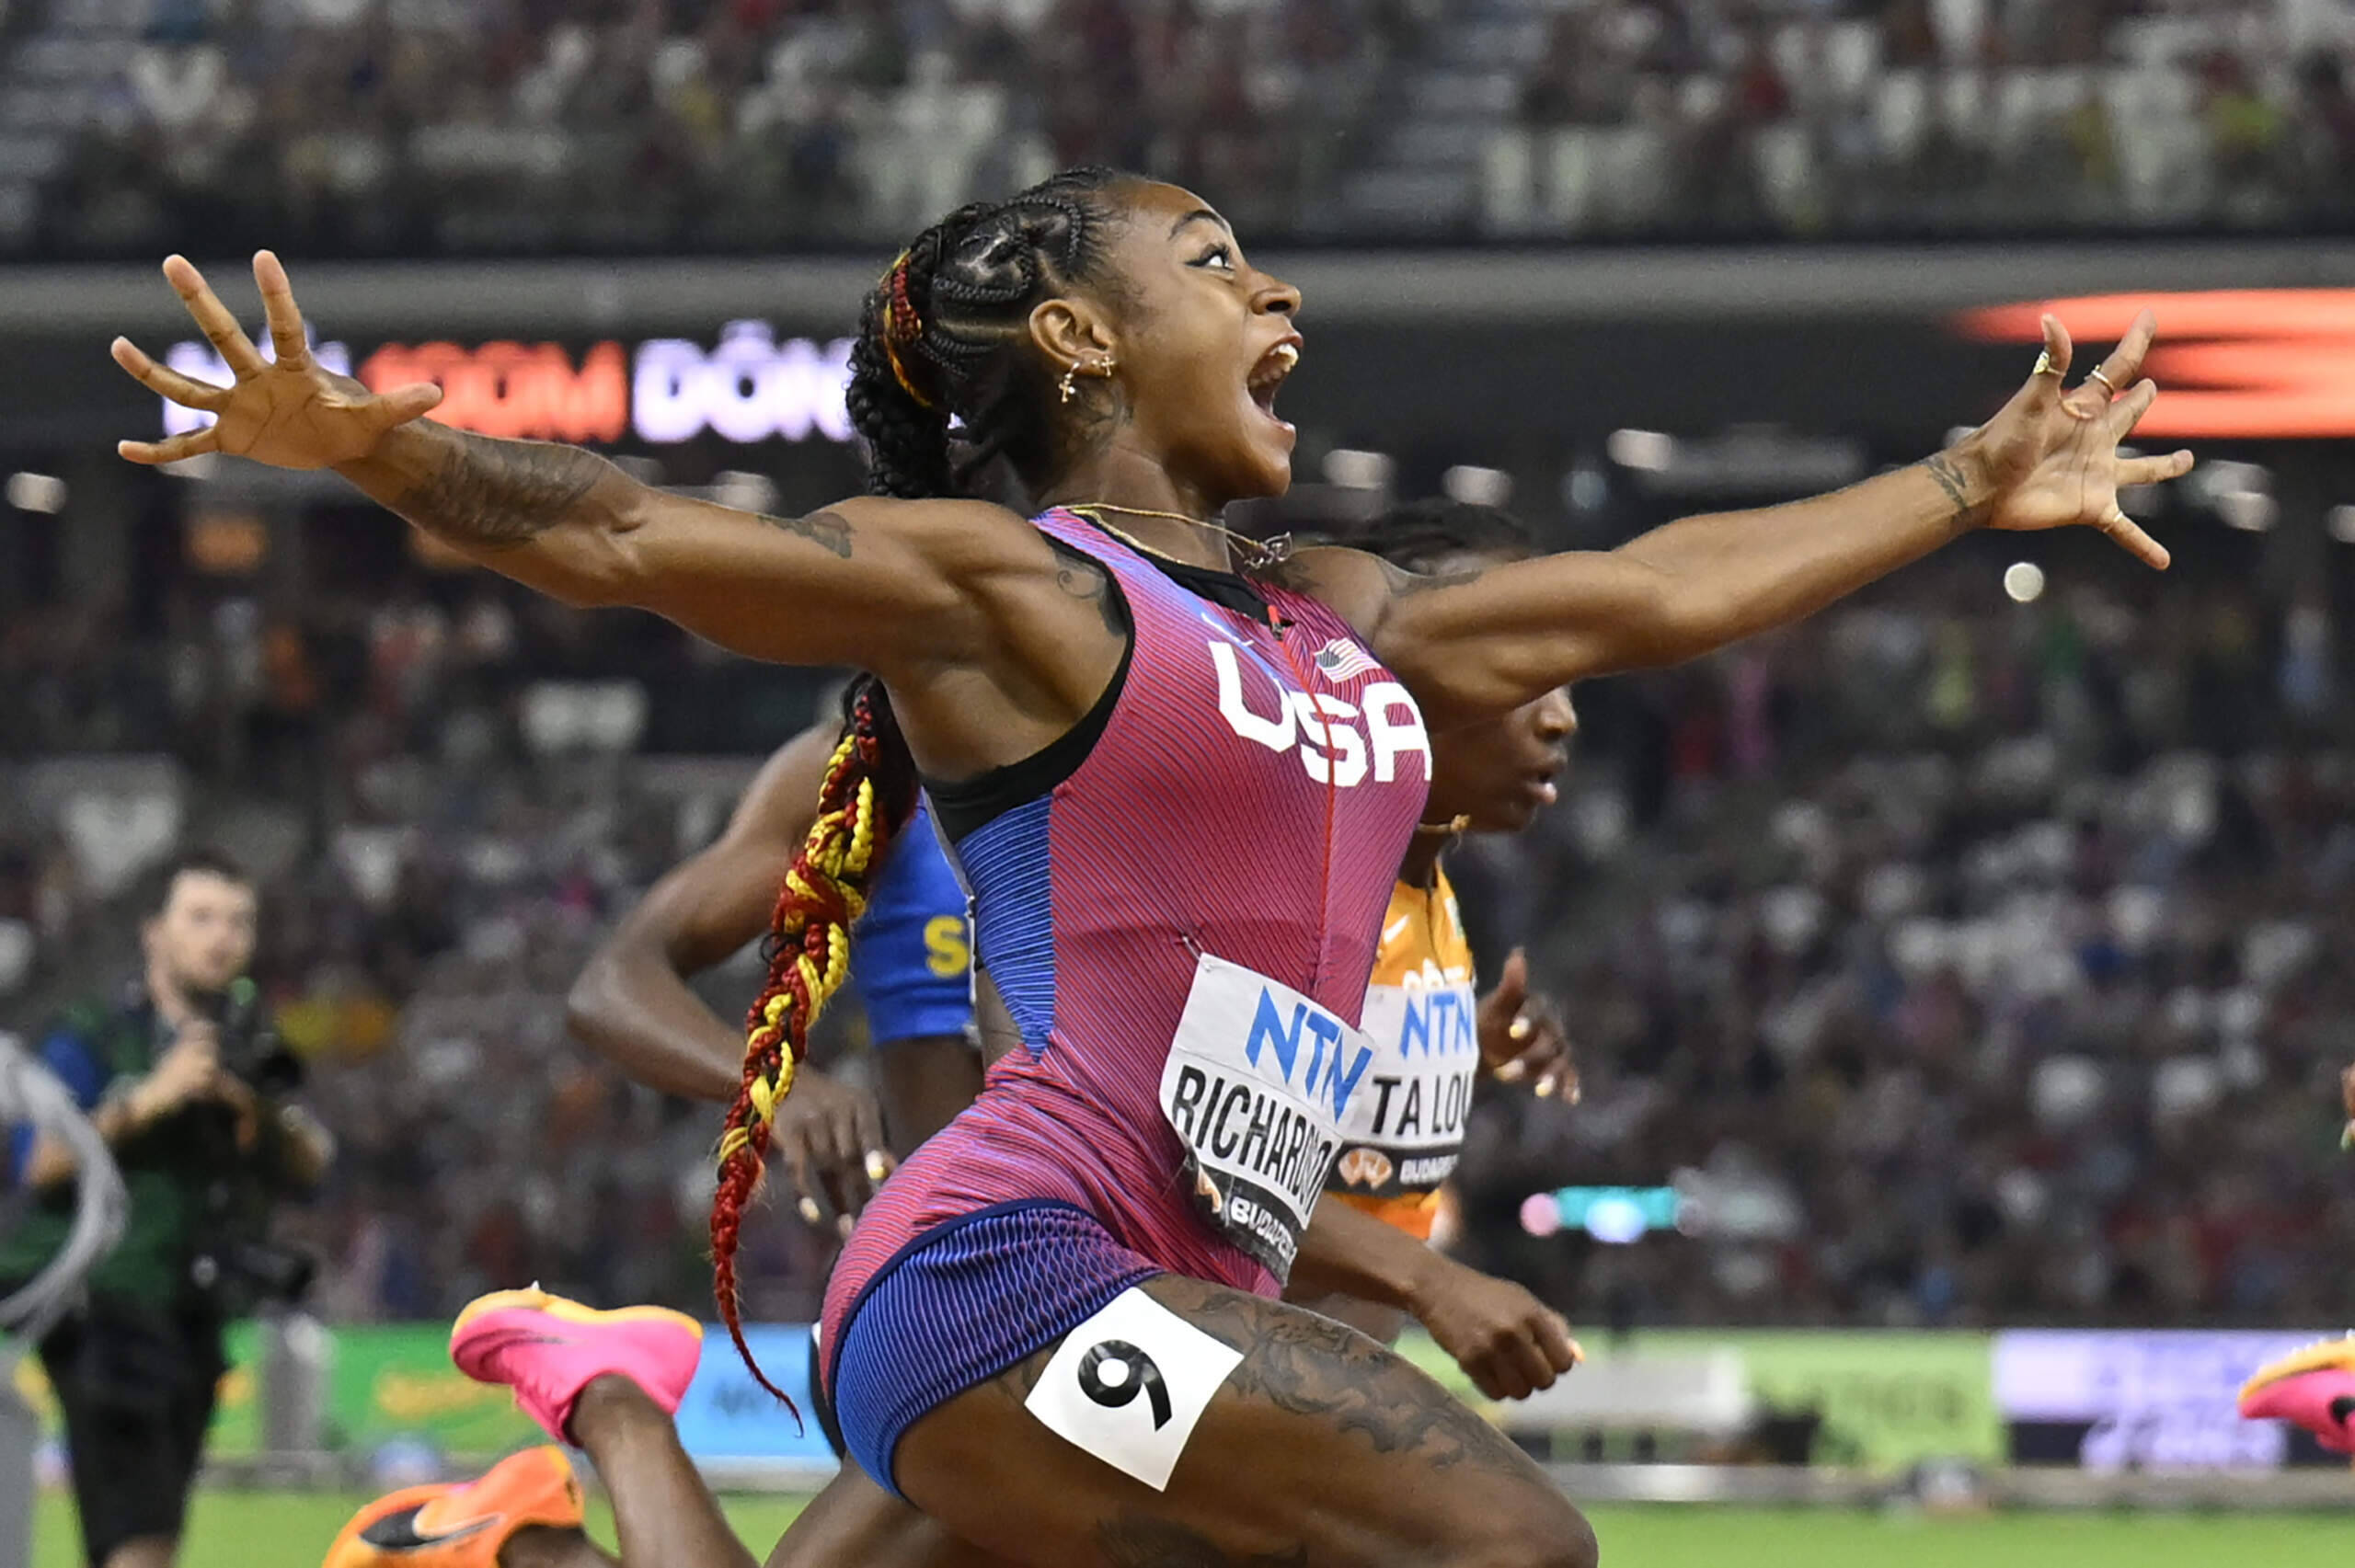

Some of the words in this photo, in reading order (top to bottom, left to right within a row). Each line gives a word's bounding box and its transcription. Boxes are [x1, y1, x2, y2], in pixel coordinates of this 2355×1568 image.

[1208, 640, 1431, 787] USA
[1245, 984, 1373, 1124] NTN
[1398, 990, 1472, 1059] NTN
[1077, 1339, 1173, 1432] 9
